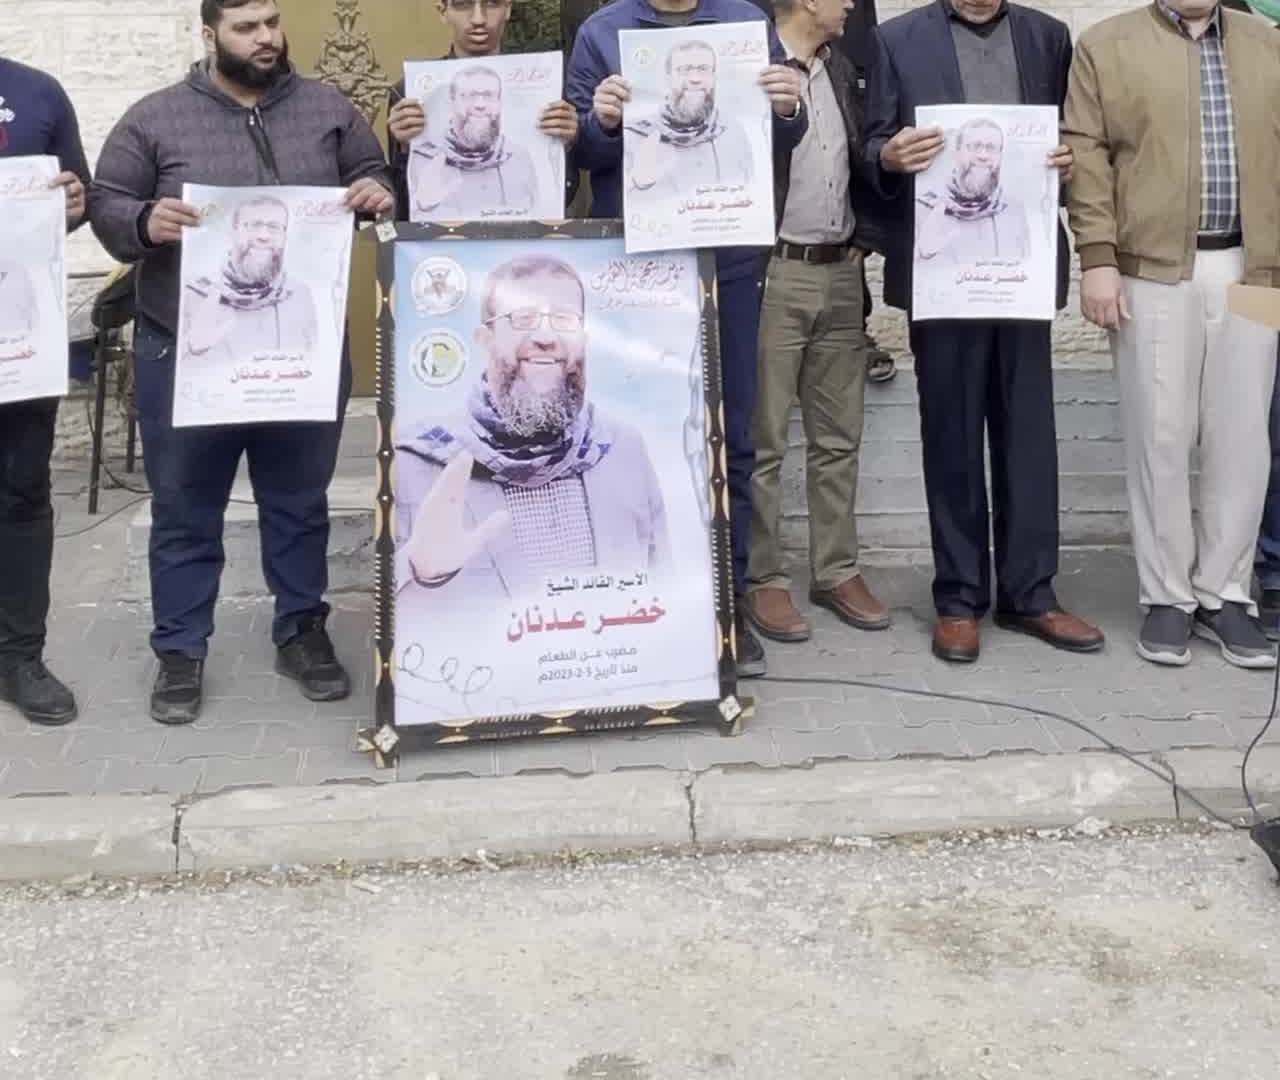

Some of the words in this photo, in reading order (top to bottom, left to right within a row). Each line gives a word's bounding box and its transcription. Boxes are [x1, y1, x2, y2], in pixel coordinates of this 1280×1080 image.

[546, 574, 580, 597] الشيخ
[507, 604, 586, 642] عدنان
[591, 596, 666, 635] خضر
